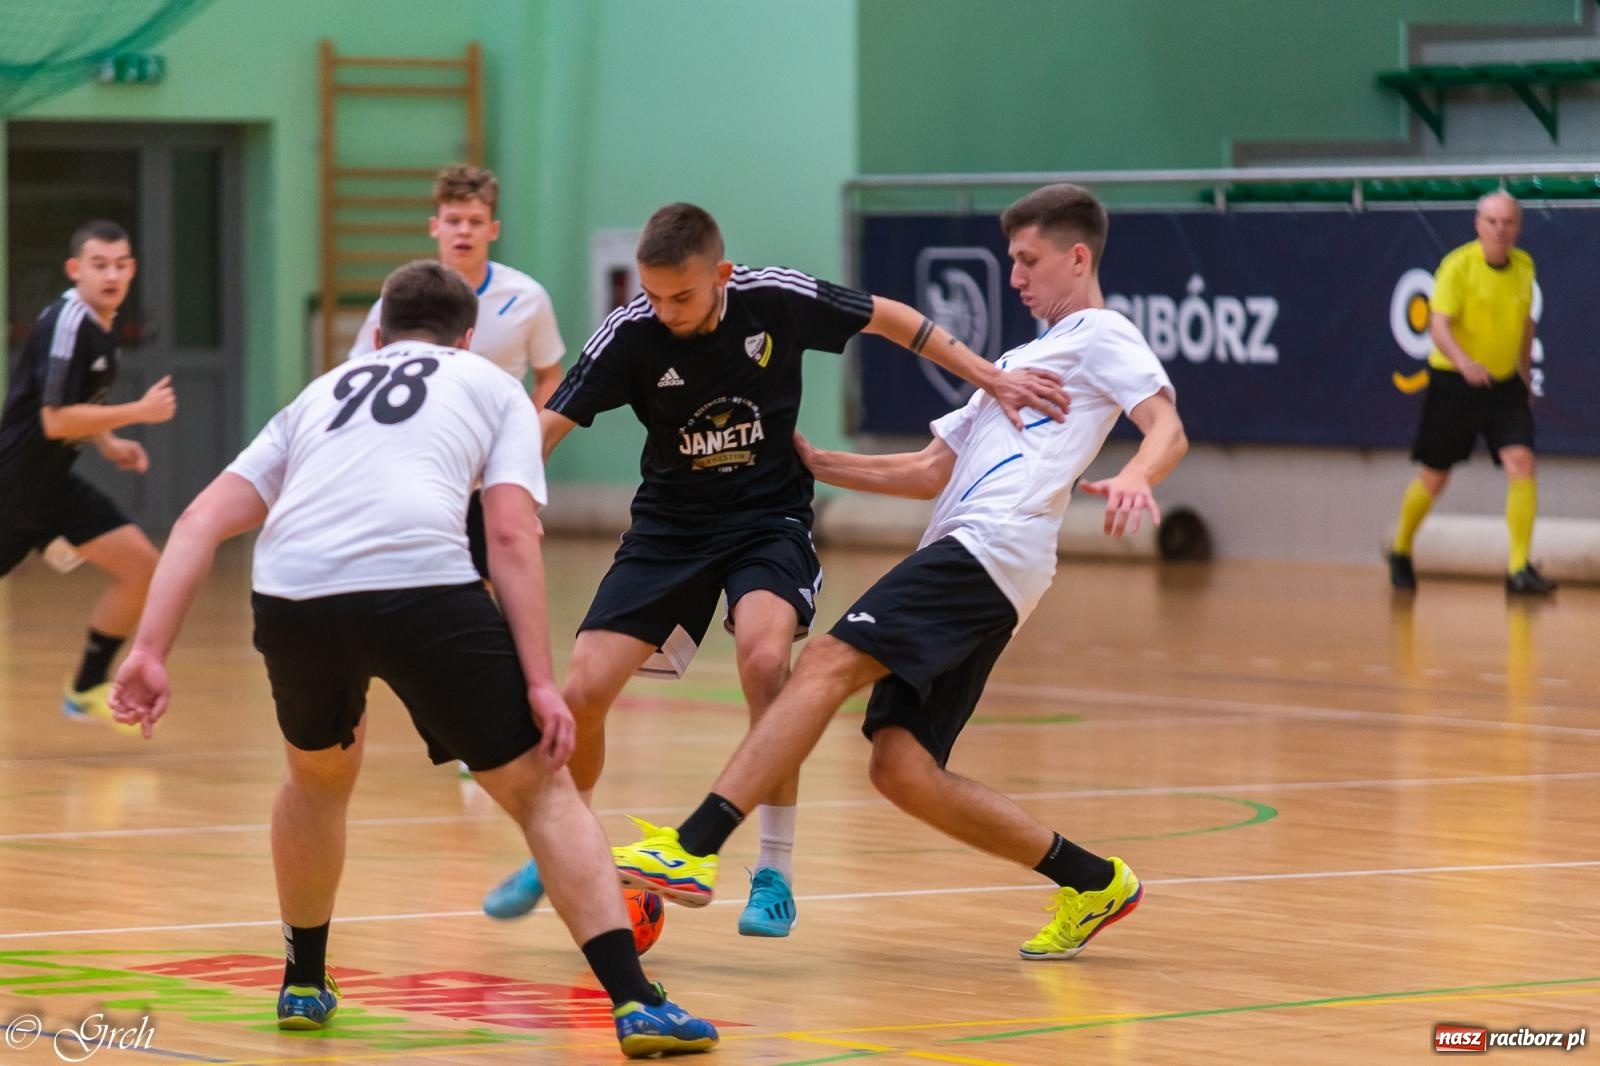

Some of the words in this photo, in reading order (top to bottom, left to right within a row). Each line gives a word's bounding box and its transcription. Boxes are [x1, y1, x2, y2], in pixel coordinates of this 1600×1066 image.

[325, 357, 439, 432] 98
[657, 379, 684, 387] adidas
[679, 420, 765, 455] JANETA
